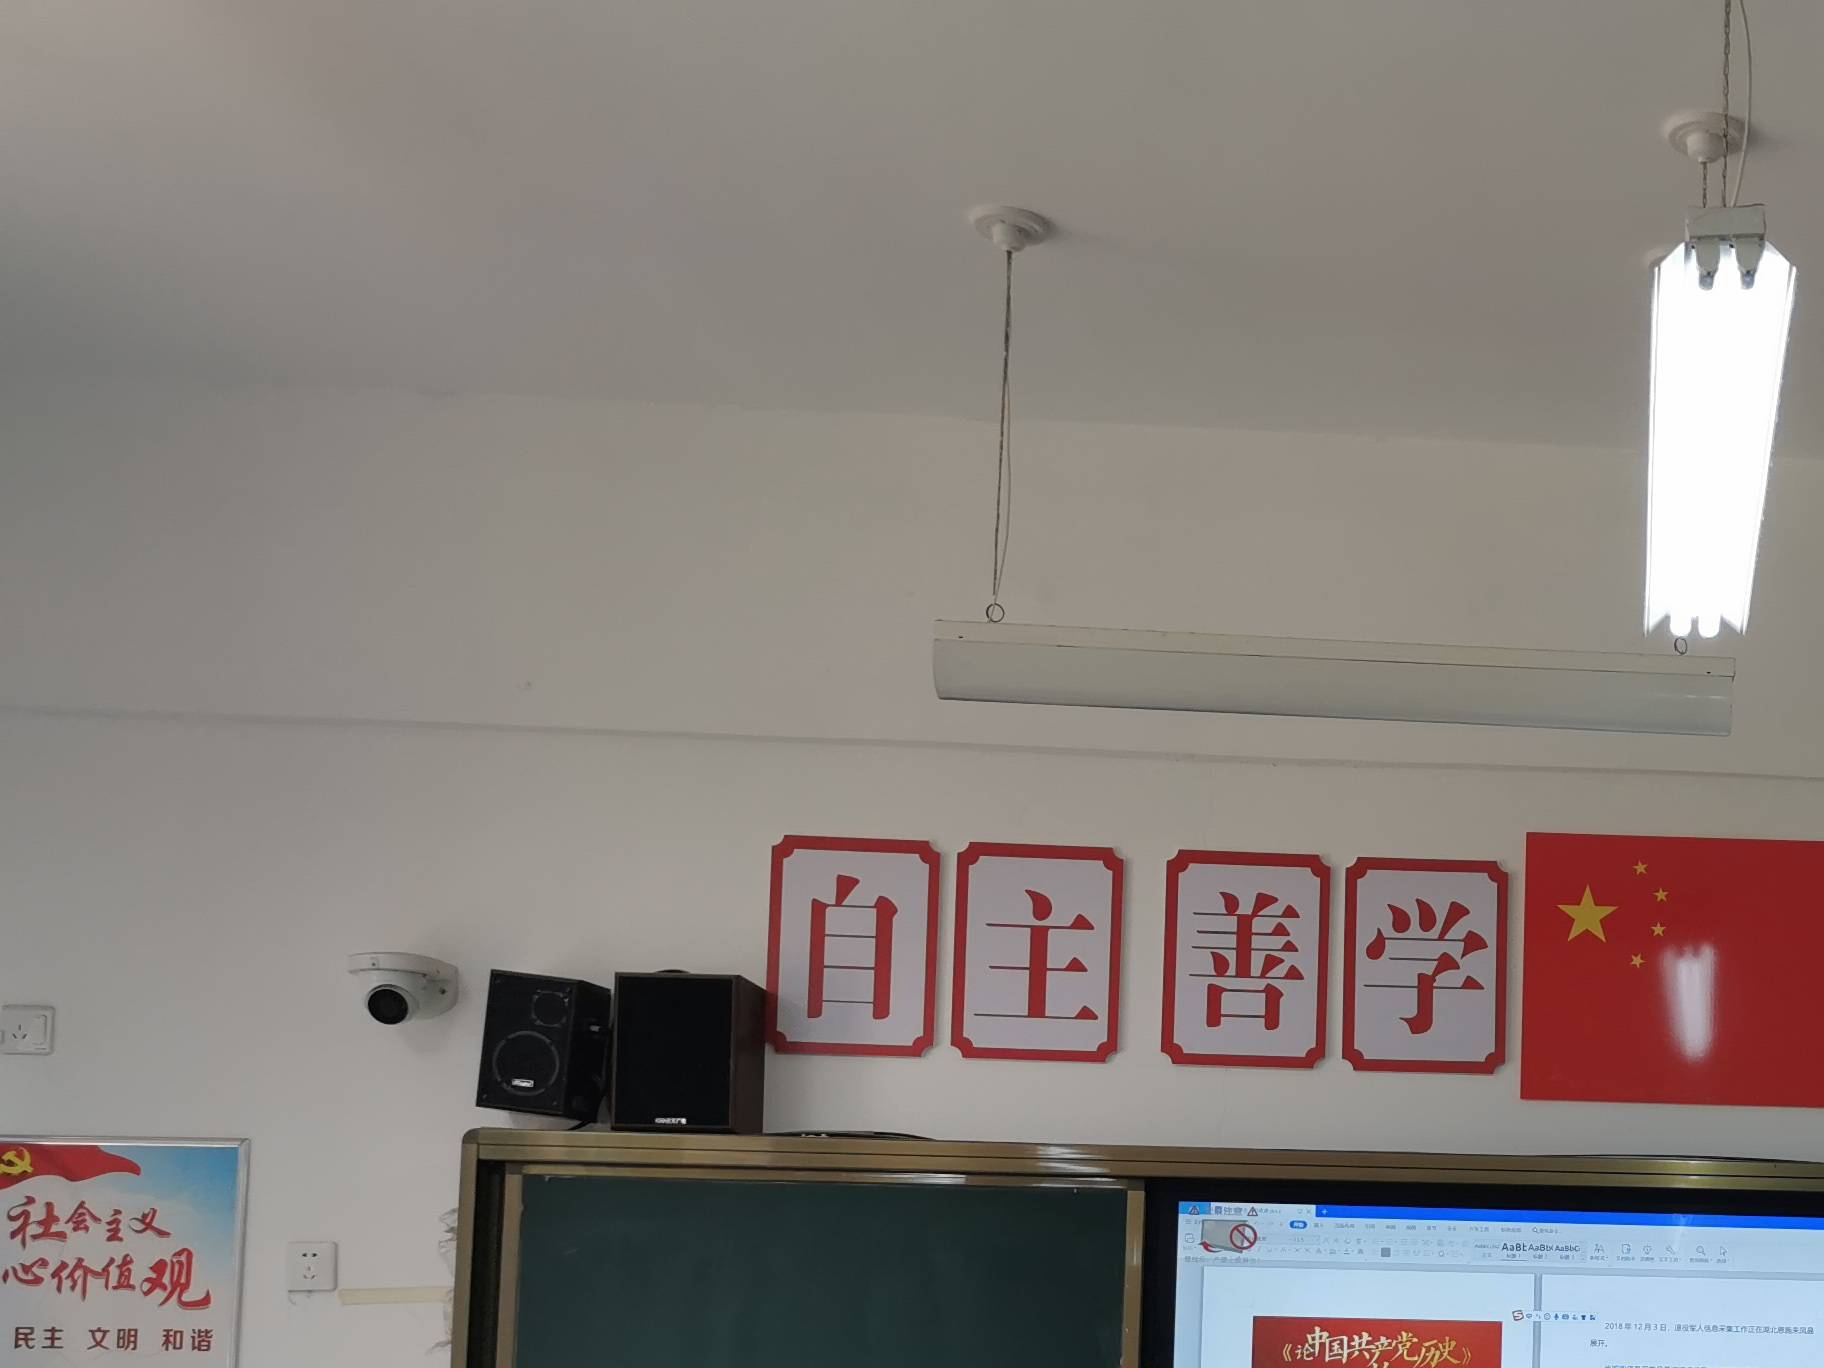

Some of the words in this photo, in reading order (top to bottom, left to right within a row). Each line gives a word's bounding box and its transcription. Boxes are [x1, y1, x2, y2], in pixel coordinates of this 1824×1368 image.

[7, 1196, 172, 1252] 社会主义
[14, 1326, 64, 1351] 民主
[87, 1327, 139, 1351] 文明
[162, 1327, 214, 1352] 和谐
[1282, 1326, 1471, 1368] 《论中国共产党历史》
